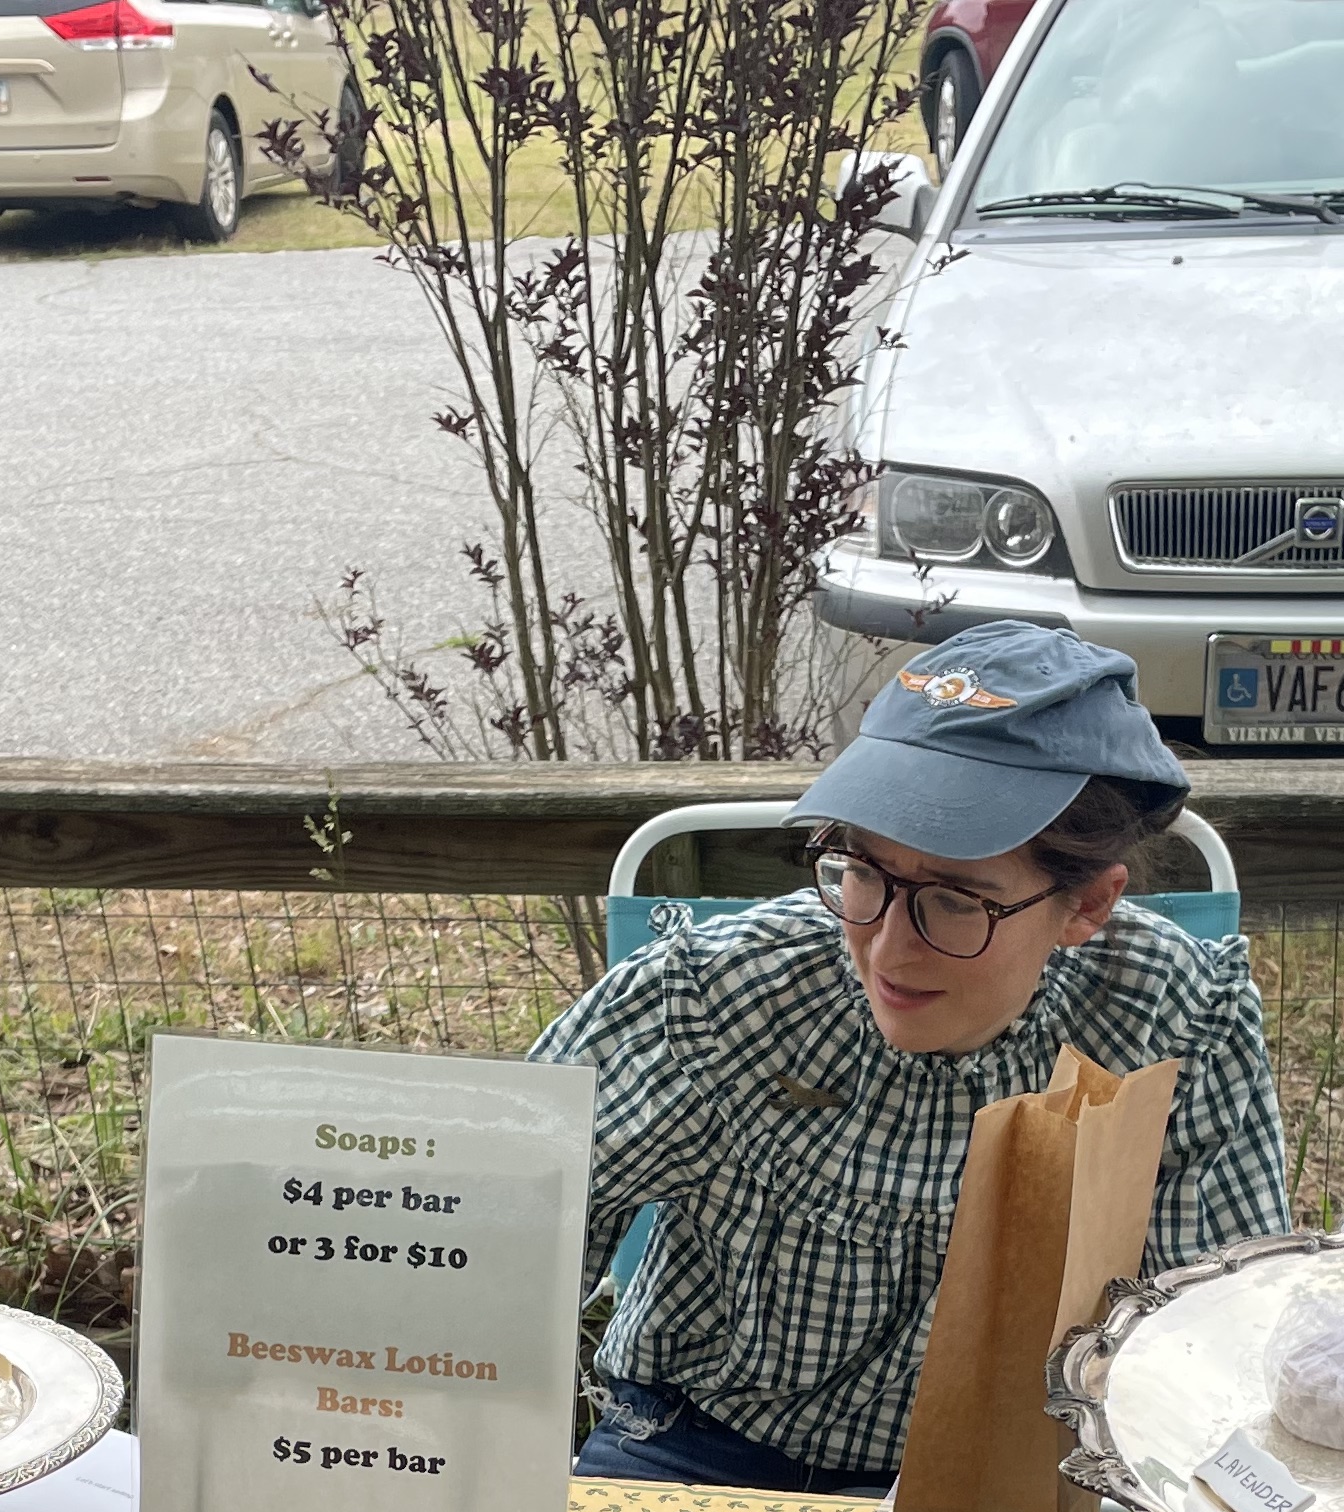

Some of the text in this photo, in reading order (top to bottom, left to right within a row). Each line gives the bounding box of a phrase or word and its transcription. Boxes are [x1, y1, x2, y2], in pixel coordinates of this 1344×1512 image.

[1227, 727, 1305, 742] VIETNAM
[283, 1177, 461, 1213] $4 per bar
[268, 1236, 468, 1268] or 3 for $10
[227, 1332, 498, 1380] Beeswax Lotion
[316, 1386, 403, 1417] Bars:
[273, 1436, 445, 1474] $5 per bar
